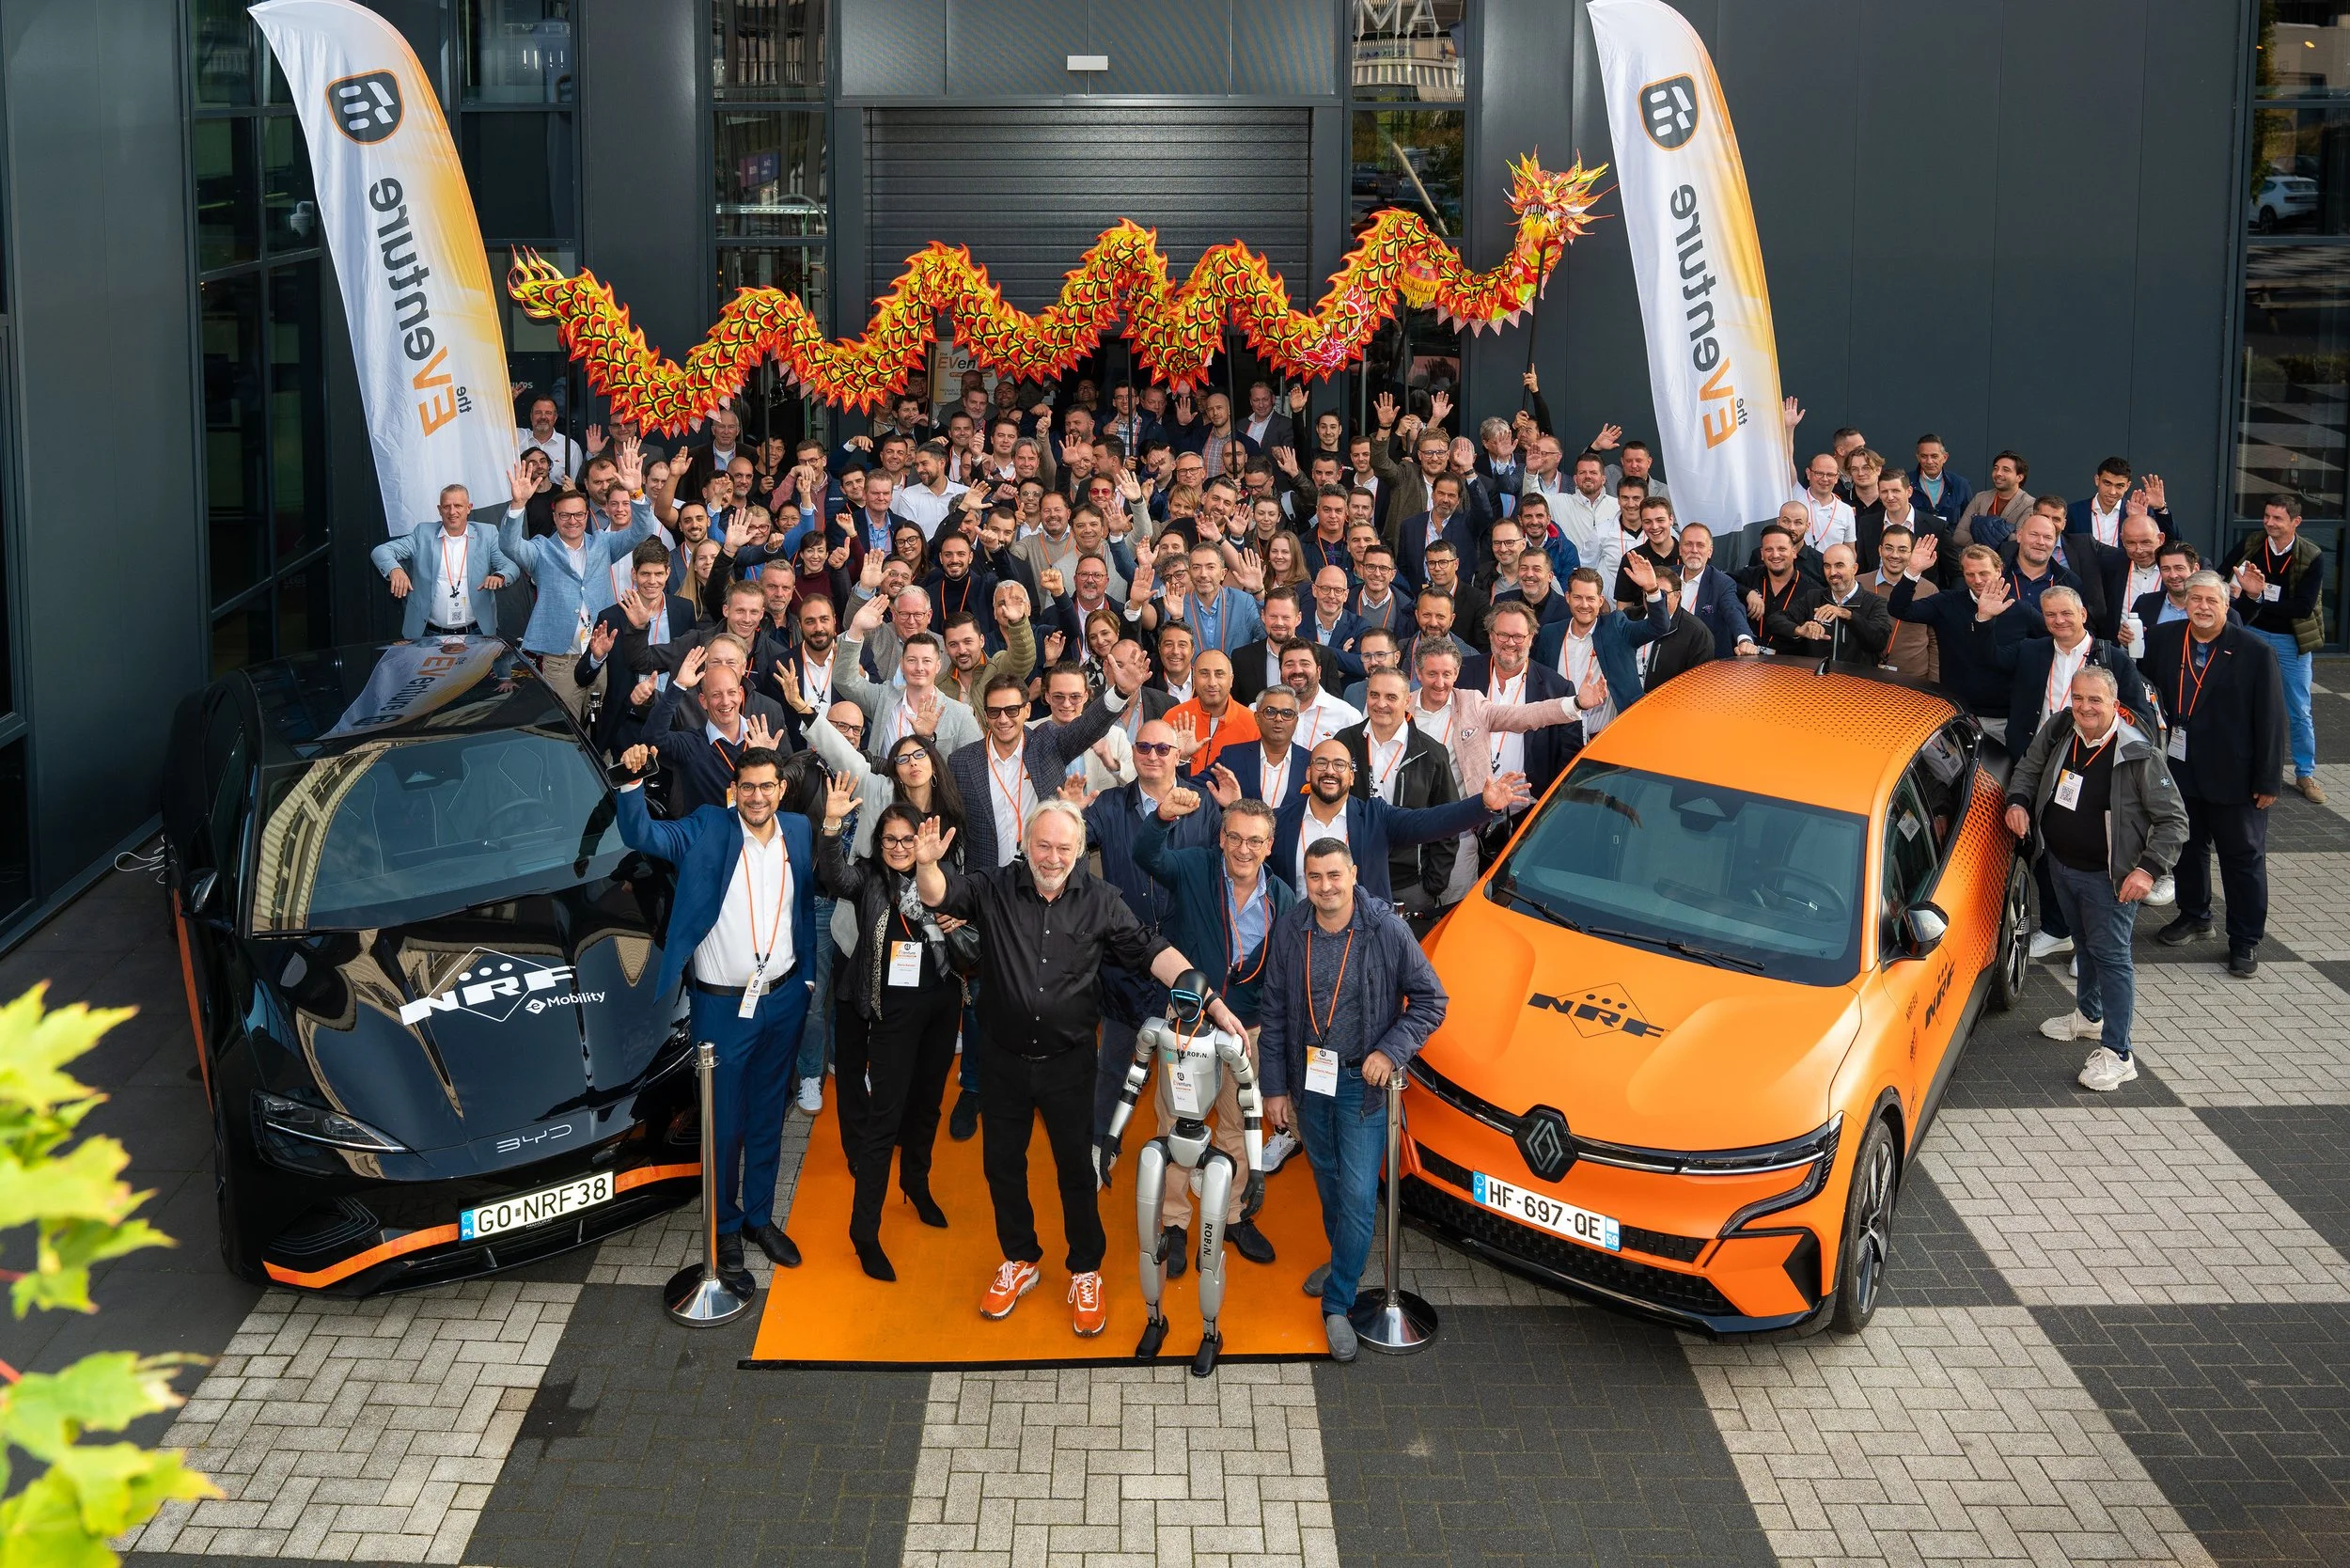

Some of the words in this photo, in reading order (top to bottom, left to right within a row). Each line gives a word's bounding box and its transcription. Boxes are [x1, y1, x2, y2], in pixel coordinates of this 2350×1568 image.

[937, 356, 985, 369] EVen
[399, 965, 573, 1026] NRF
[546, 992, 605, 1008] Mobility
[1528, 993, 1666, 1038] NRF
[1925, 960, 1955, 1030] NRF
[496, 1124, 572, 1153] BYD
[1490, 1181, 1601, 1241] HF-697-QE
[1606, 1233, 1618, 1247] 59
